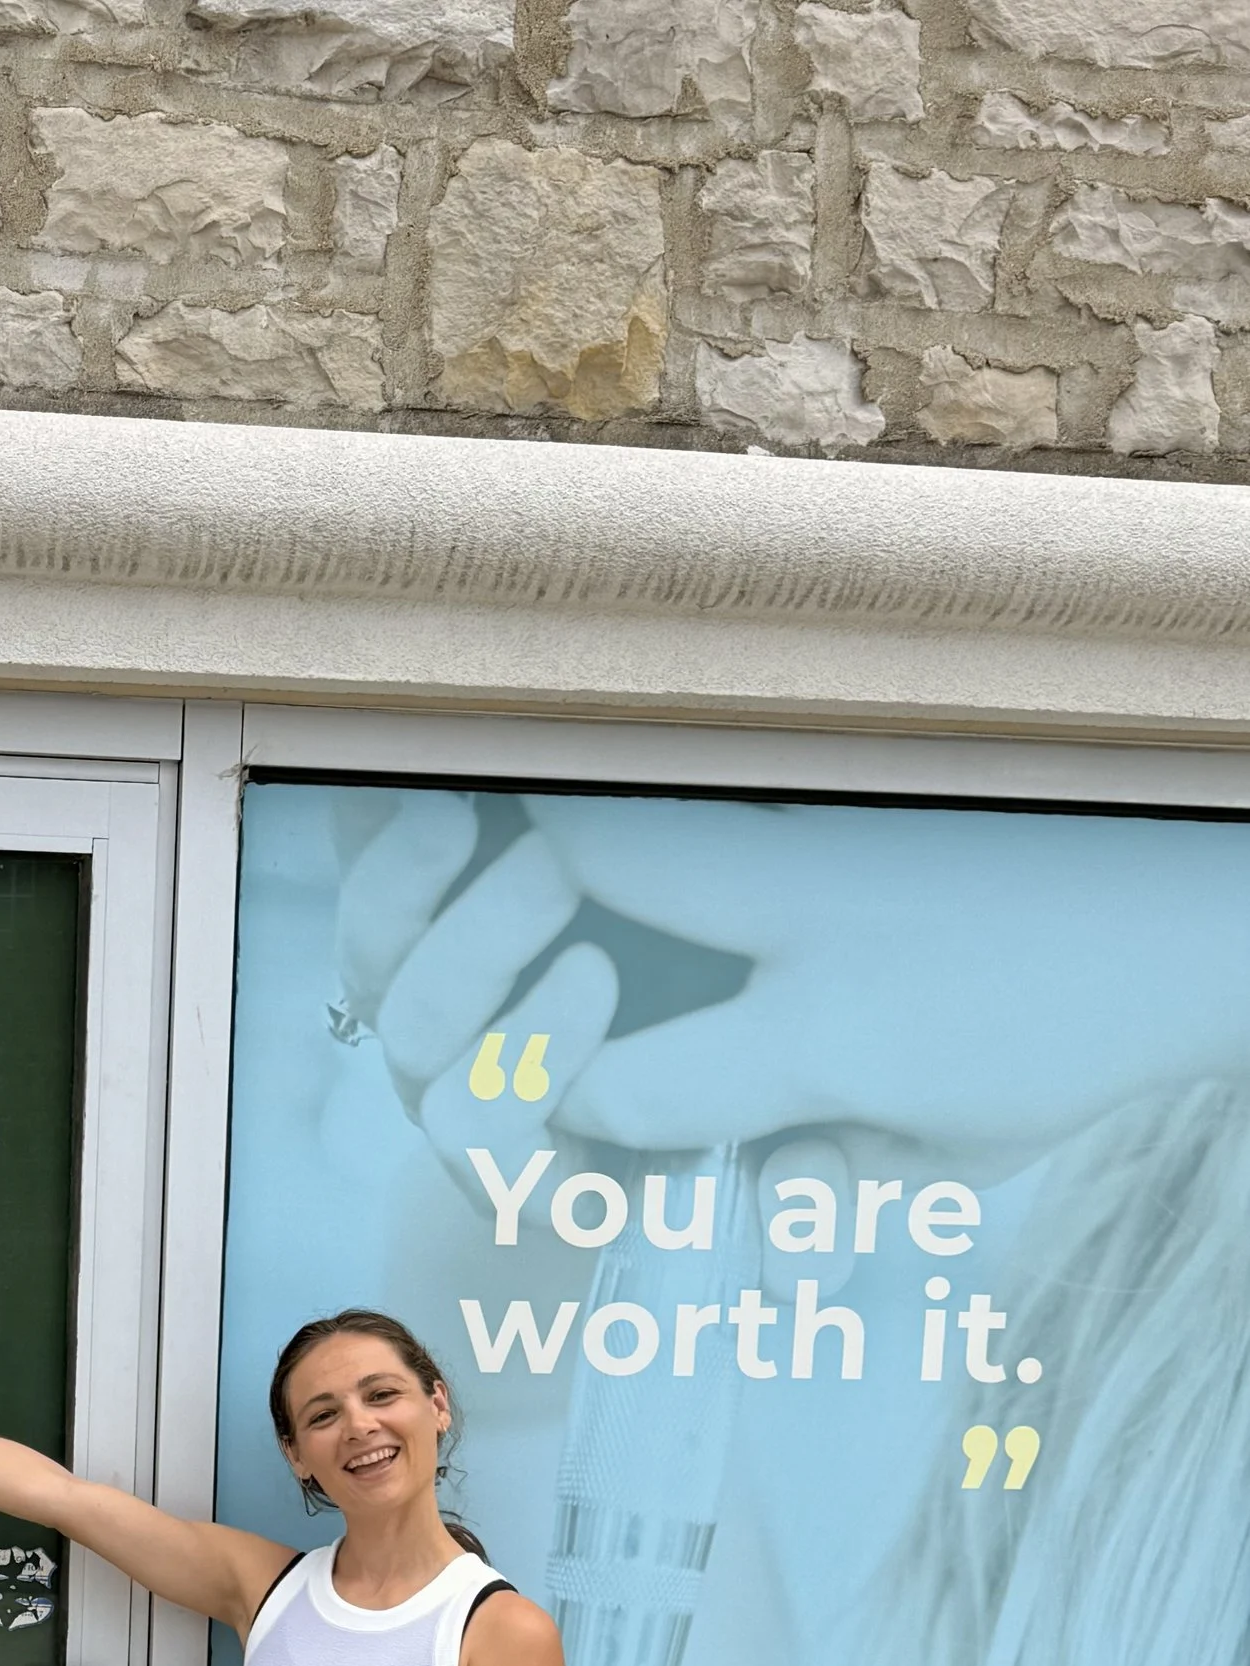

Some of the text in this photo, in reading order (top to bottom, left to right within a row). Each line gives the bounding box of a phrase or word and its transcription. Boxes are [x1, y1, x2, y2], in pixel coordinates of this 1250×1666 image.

[466, 1148, 982, 1257] You are
[459, 1276, 1043, 1384] worth it.
